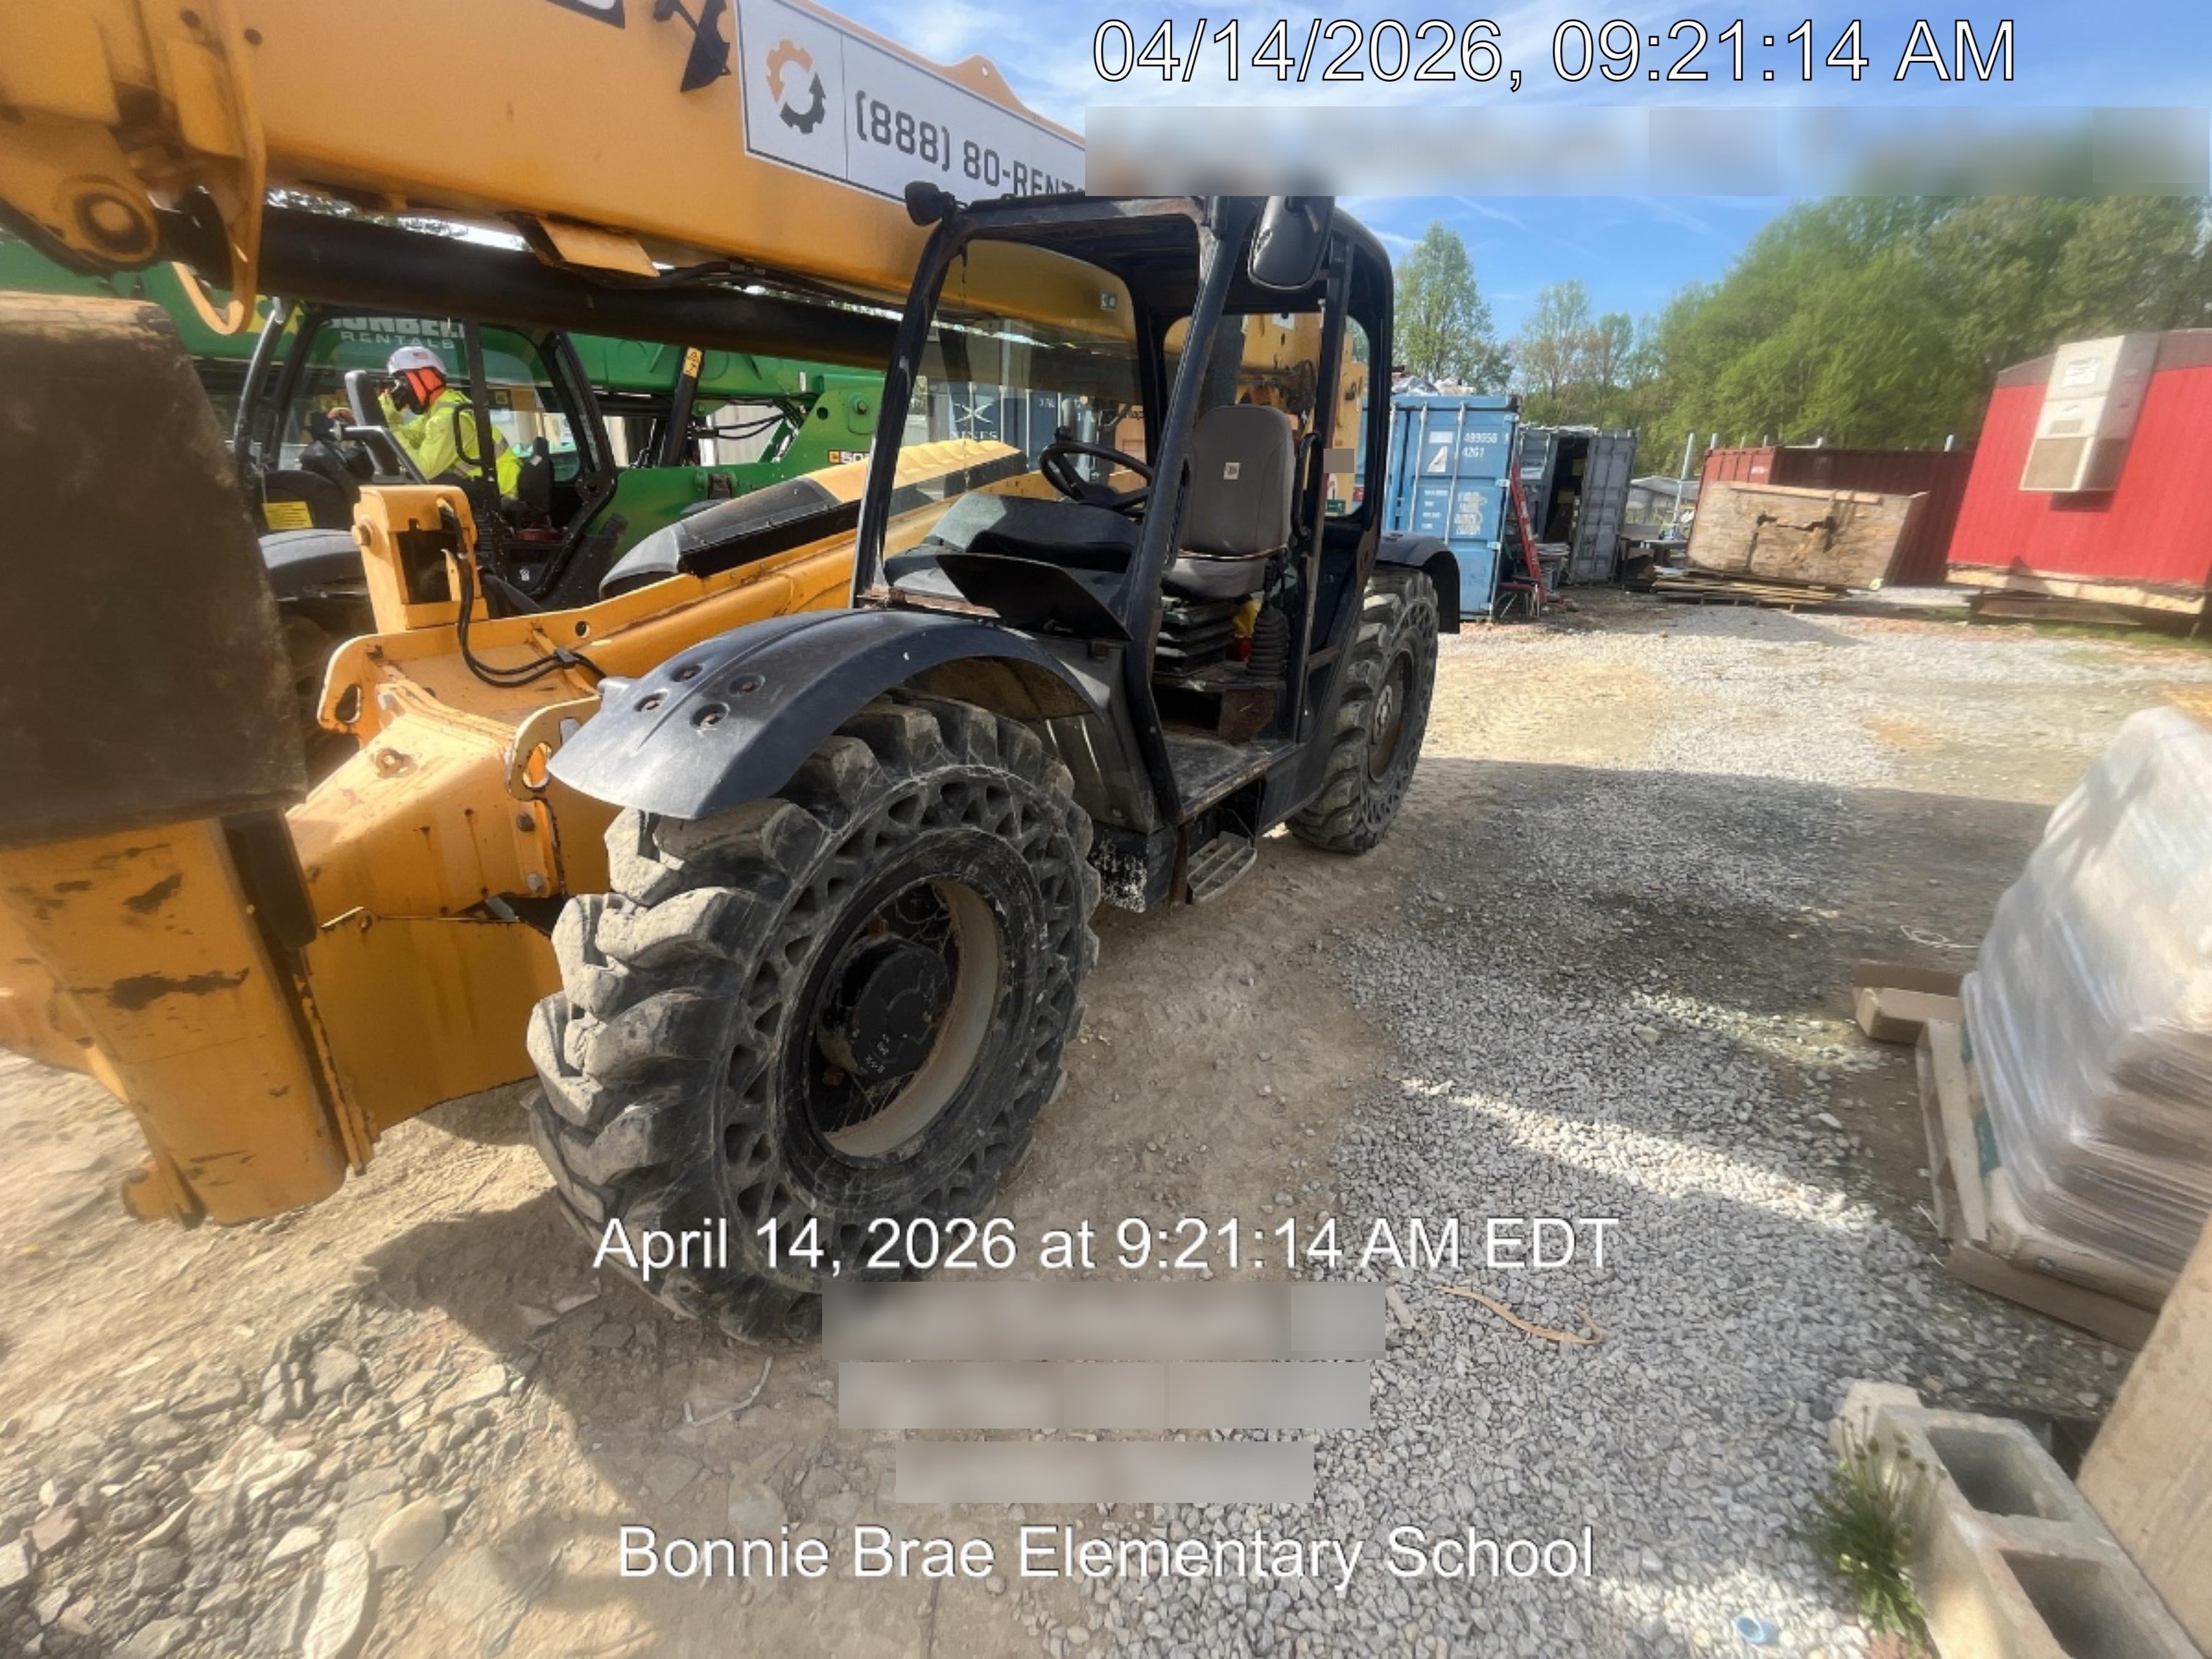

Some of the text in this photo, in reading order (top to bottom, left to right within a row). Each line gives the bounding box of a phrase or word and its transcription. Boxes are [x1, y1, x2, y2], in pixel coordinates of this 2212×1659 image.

[855, 90, 1085, 195] (888) 80-REN
[340, 331, 455, 350] RENTALS
